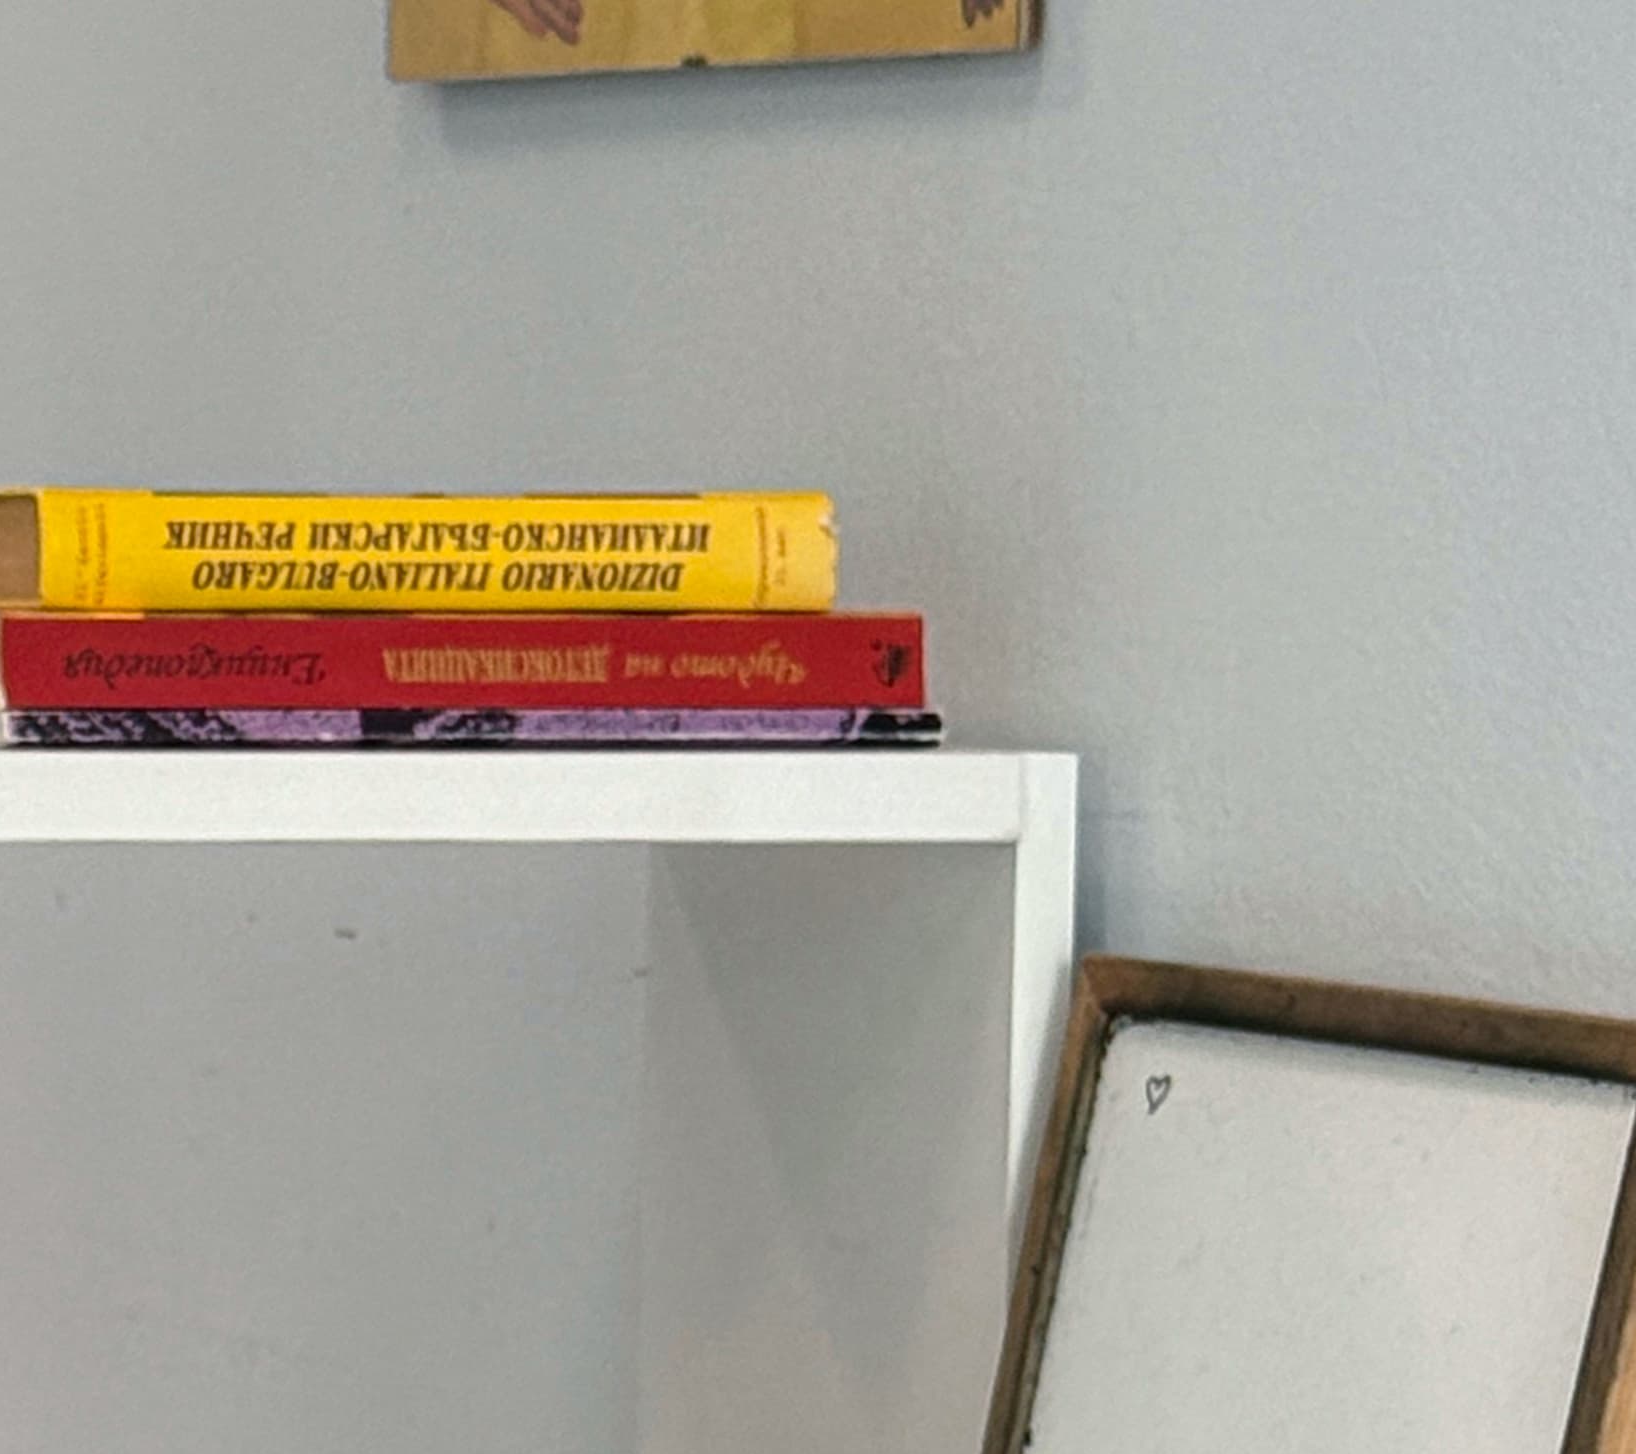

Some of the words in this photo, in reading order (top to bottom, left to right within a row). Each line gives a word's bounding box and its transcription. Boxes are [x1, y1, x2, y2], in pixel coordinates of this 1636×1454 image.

[163, 521, 296, 552] РЕЧНИК
[308, 521, 710, 552] ИТАЛИАНСКО-БЪЛГАРСКИ
[192, 561, 492, 592] ITALIANO-BULGARO
[502, 562, 684, 592] DIZIONARIO
[63, 643, 326, 690] Енциклопедия
